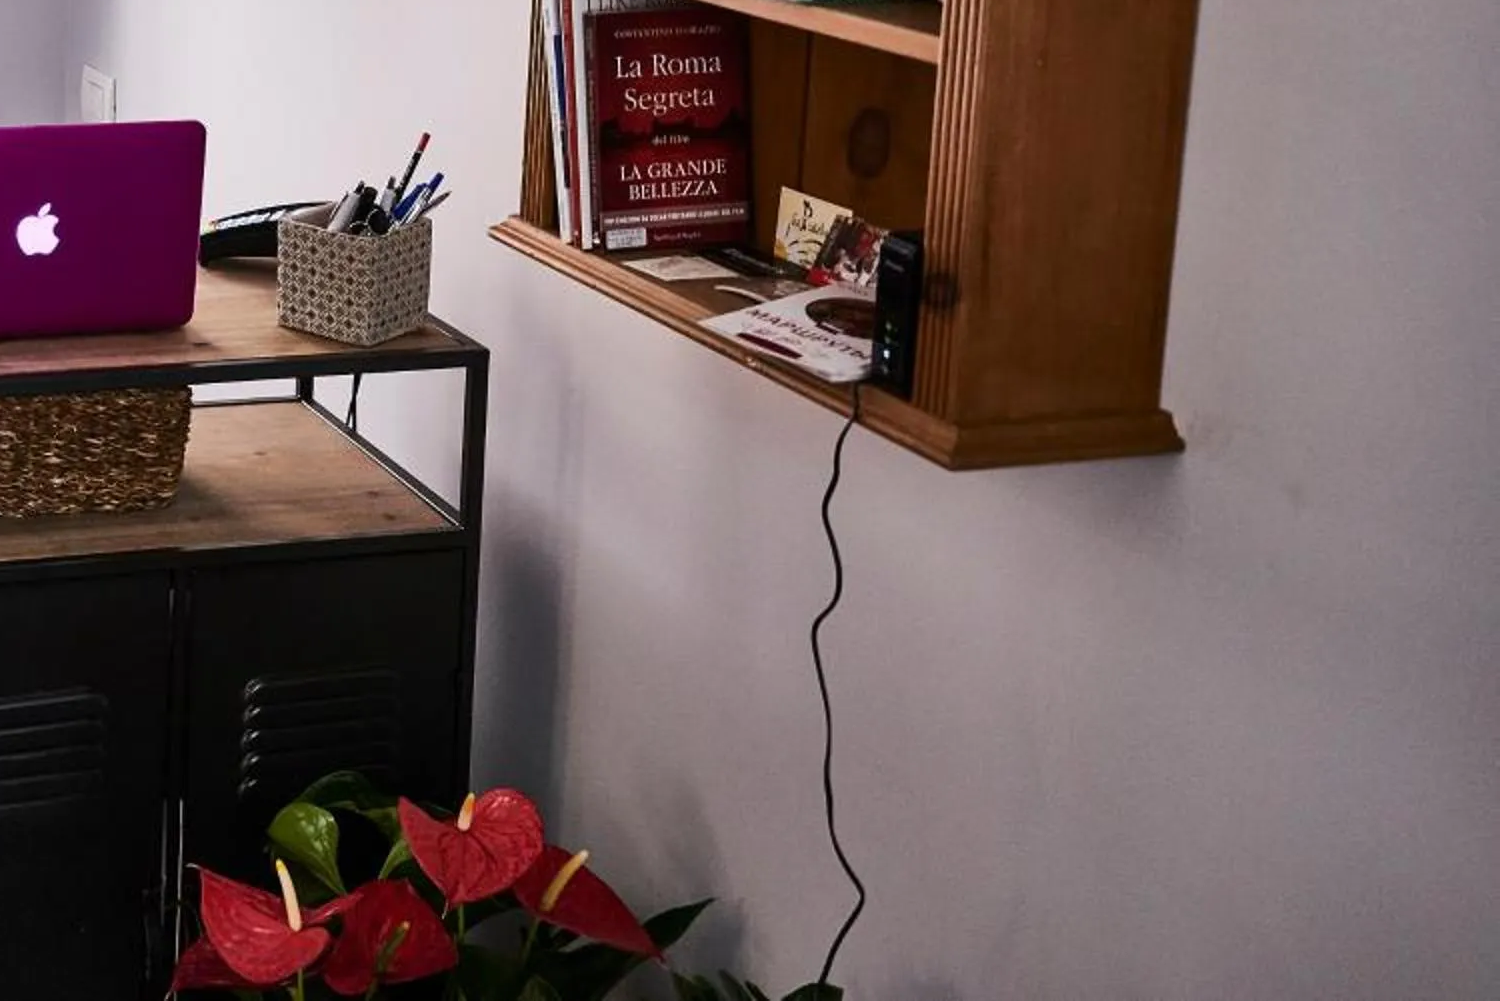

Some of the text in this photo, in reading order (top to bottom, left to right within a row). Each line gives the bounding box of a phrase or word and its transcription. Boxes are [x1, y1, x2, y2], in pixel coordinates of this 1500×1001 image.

[614, 53, 722, 79] La Roma
[624, 87, 715, 117] Segreta
[652, 134, 667, 146] del
[620, 158, 728, 182] LA GRANDE
[628, 179, 719, 201] BELLEZZA
